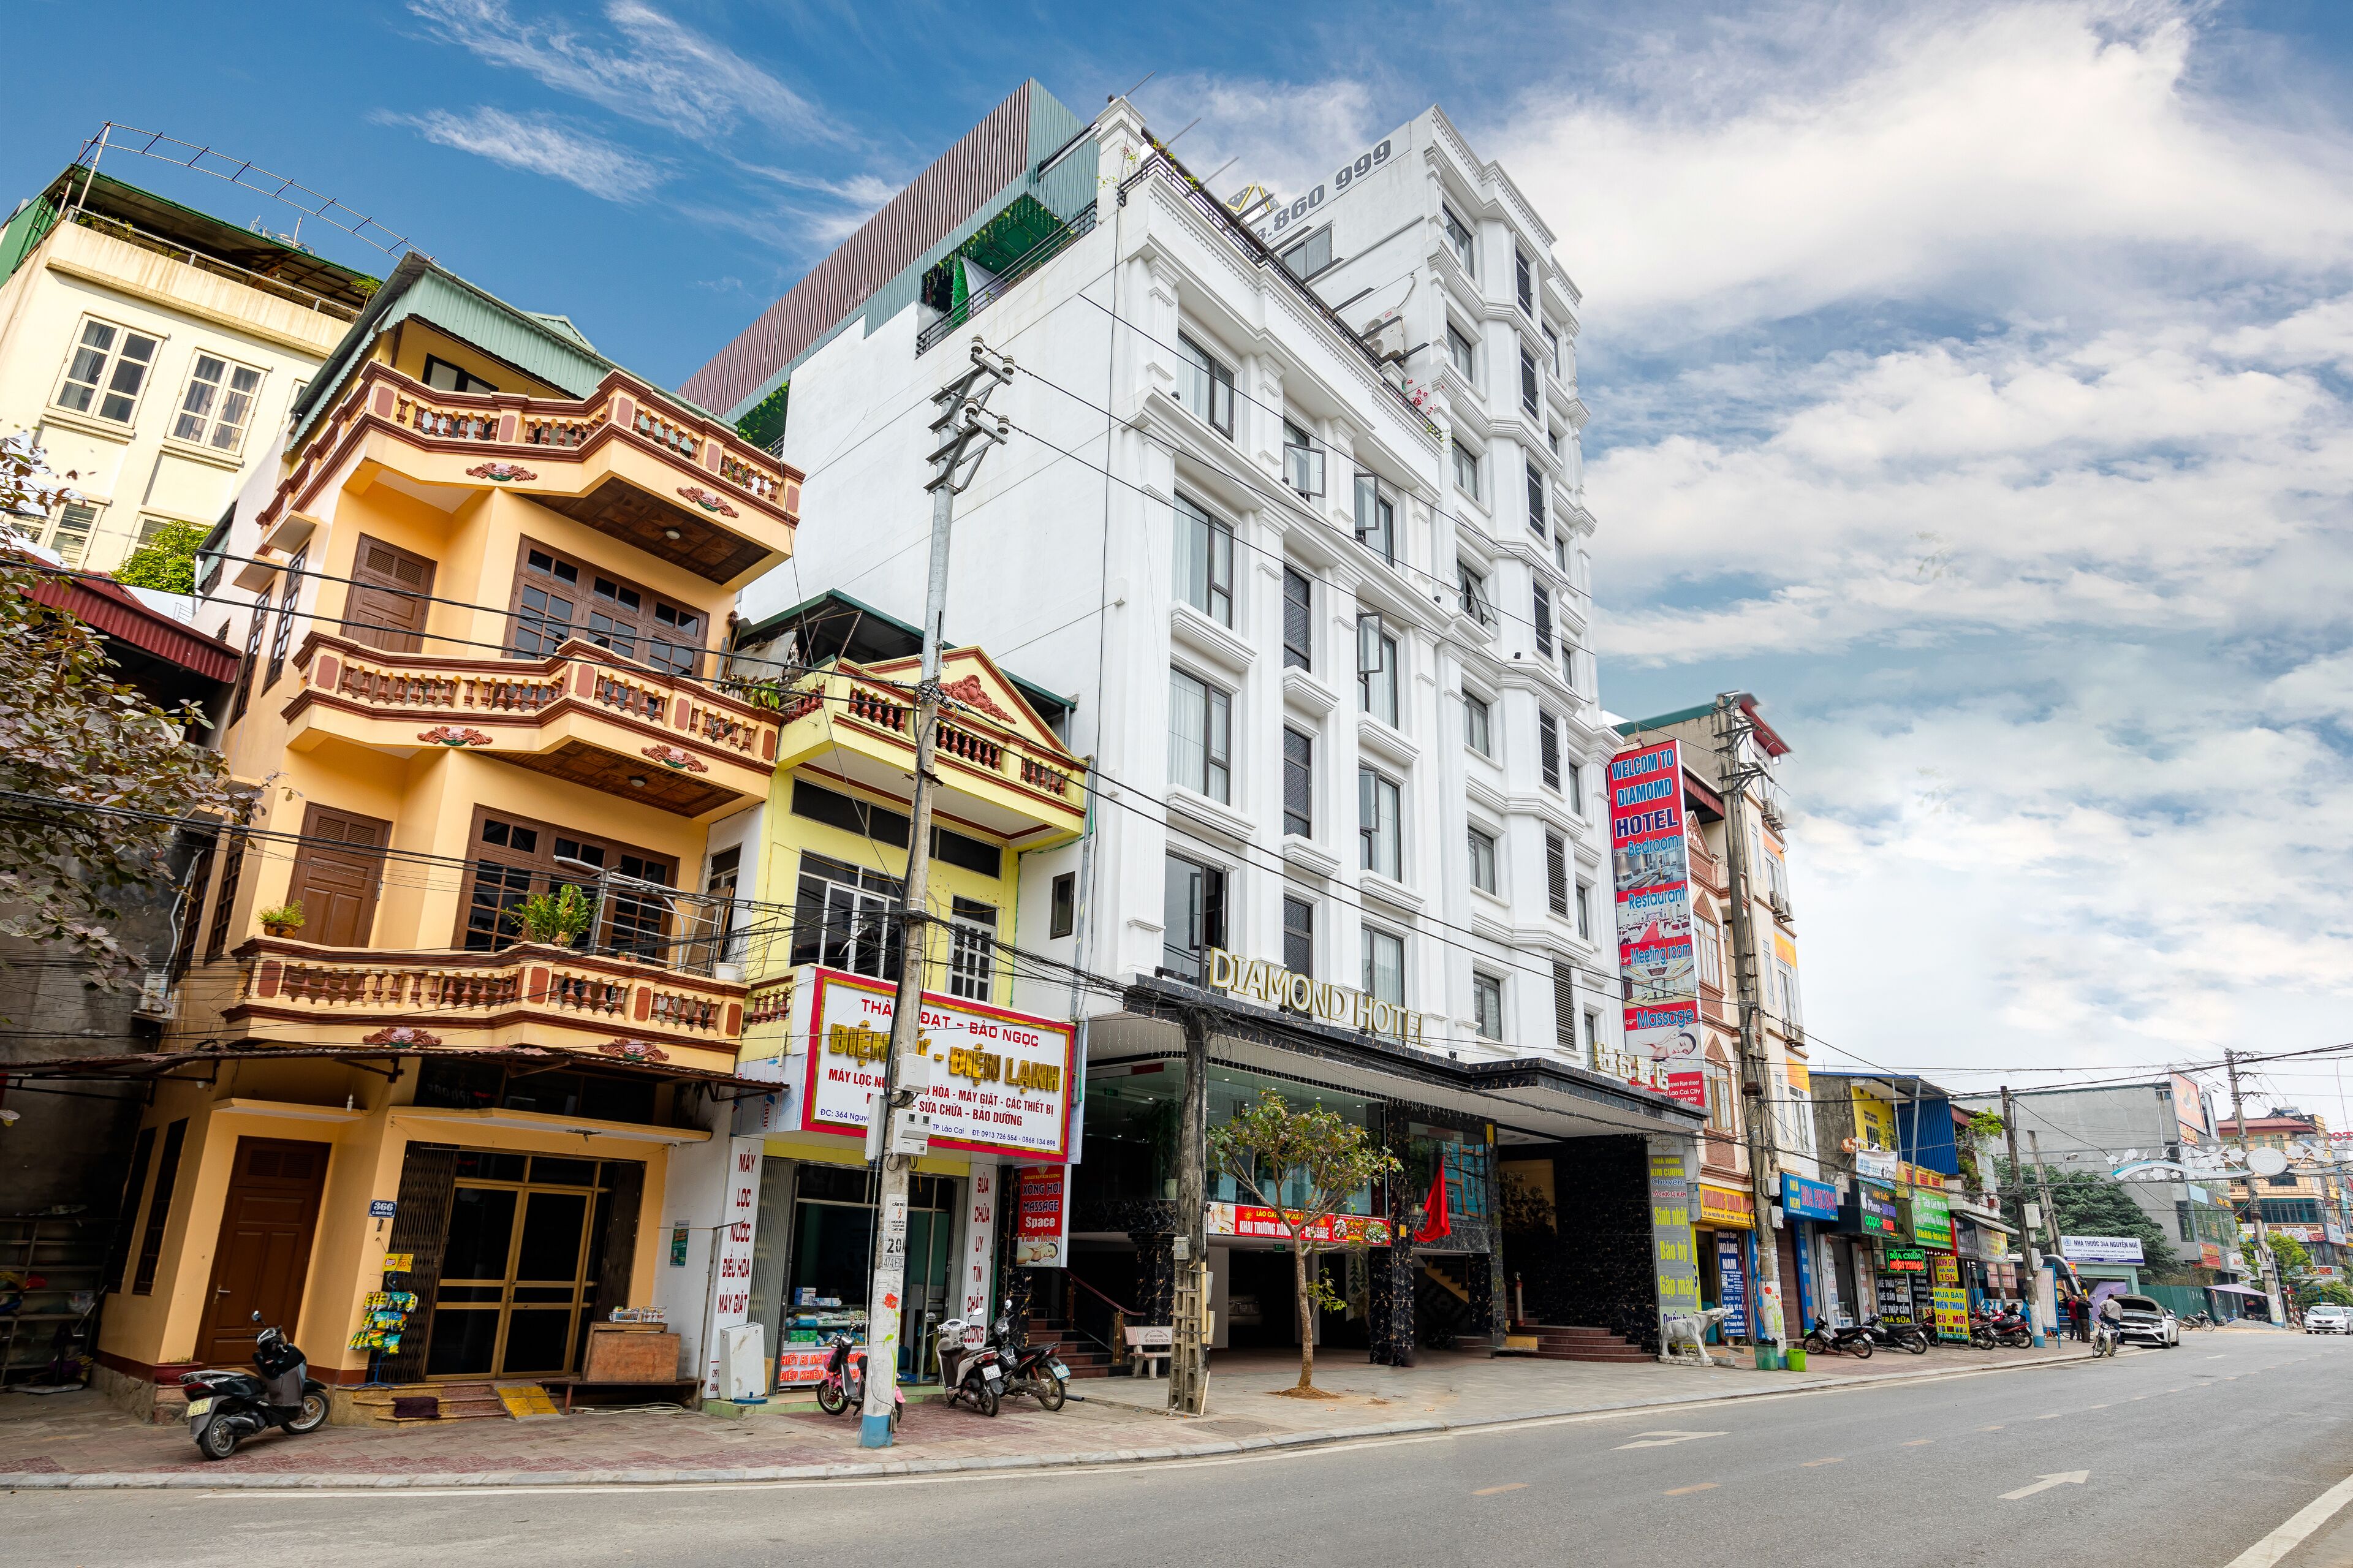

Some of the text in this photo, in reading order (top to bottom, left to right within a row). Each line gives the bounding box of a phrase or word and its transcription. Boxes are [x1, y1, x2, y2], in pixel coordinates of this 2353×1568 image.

[1336, 140, 1391, 191] 999
[1612, 749, 1675, 781] WELCOM TO
[1615, 808, 1679, 838] HOTEL
[1628, 835, 1678, 857] Bedroom
[1629, 884, 1685, 909] Restaurant
[1631, 943, 1691, 964] Meeting room
[1210, 947, 1431, 1048] DIAMOND HOTEL
[1637, 1009, 1694, 1029] Massage
[920, 1013, 950, 1029] ĐẠT
[969, 1020, 997, 1039] BẢO
[1002, 1029, 1039, 1047] NGỌC
[828, 1068, 851, 1083] MÁY
[853, 1072, 871, 1088] LỌC
[949, 1043, 1001, 1086] ĐIỆN
[1006, 1057, 1061, 1094] LẠNH
[932, 1084, 949, 1099] HÒA
[958, 1089, 977, 1103] MÁY
[980, 1093, 998, 1108] GIẶT
[1006, 1097, 1021, 1110] CÁC
[1024, 1099, 1044, 1113] THIẾT
[1046, 1104, 1054, 1117] BỊ
[835, 1110, 847, 1119] 364
[919, 1097, 1022, 1126] SỬA CHỮA BẢO DƯỠNG
[738, 1147, 756, 1173] MÁY
[1651, 1168, 1662, 1176] KIM
[1651, 1177, 1686, 1187] Chuyên:
[977, 1171, 990, 1194] SỬA
[1022, 1181, 1062, 1196] XÔNG HƠI
[1789, 1179, 1799, 1192] NHÀ
[373, 1202, 394, 1211] 366
[737, 1188, 751, 1212] LỌC
[1023, 1200, 1059, 1213] MASSAGE
[1789, 1194, 1800, 1210] NGHỈ
[1800, 1184, 1836, 1216] HOA PHƯỢNG
[974, 1204, 990, 1224] CHỮA
[1025, 1216, 1055, 1229] Space
[1654, 1206, 1689, 1230] Sinh nhật
[1865, 1215, 1881, 1230] oppo
[730, 1218, 751, 1243] NƯỚC
[1240, 1221, 1253, 1233] KHAI
[1254, 1221, 1276, 1235] TRƯƠNG
[975, 1235, 984, 1252] UY
[1659, 1240, 1676, 1260] Báo
[1719, 1241, 1738, 1254] HOÀNG
[2110, 1240, 2128, 1248] NGUYỄN
[2129, 1241, 2138, 1250] HUỆ
[722, 1246, 749, 1278] ĐIỀU HÒA
[1722, 1259, 1737, 1270] NAM
[1889, 1250, 1922, 1260] SỬA CHỮA
[1890, 1259, 1924, 1271] ĐIỆN THOẠI
[1936, 1258, 1947, 1267] BÁNH
[973, 1260, 982, 1283] TÍN
[1659, 1275, 1676, 1299] Gặp
[1678, 1275, 1694, 1300] mặt
[1885, 1278, 1895, 1288] THÁI
[718, 1287, 748, 1318] MÁY GIẶT
[967, 1287, 983, 1312] CHẤT
[1951, 1290, 1964, 1298] BÁN
[1888, 1303, 1909, 1316] THẬP CẨM
[1936, 1300, 1949, 1311] ĐIỆN
[1950, 1301, 1965, 1312] THOẠI
[1937, 1313, 1966, 1325] CŨ MỚI
[800, 1354, 809, 1366] BỊ
[800, 1366, 824, 1381] KHIỂN
